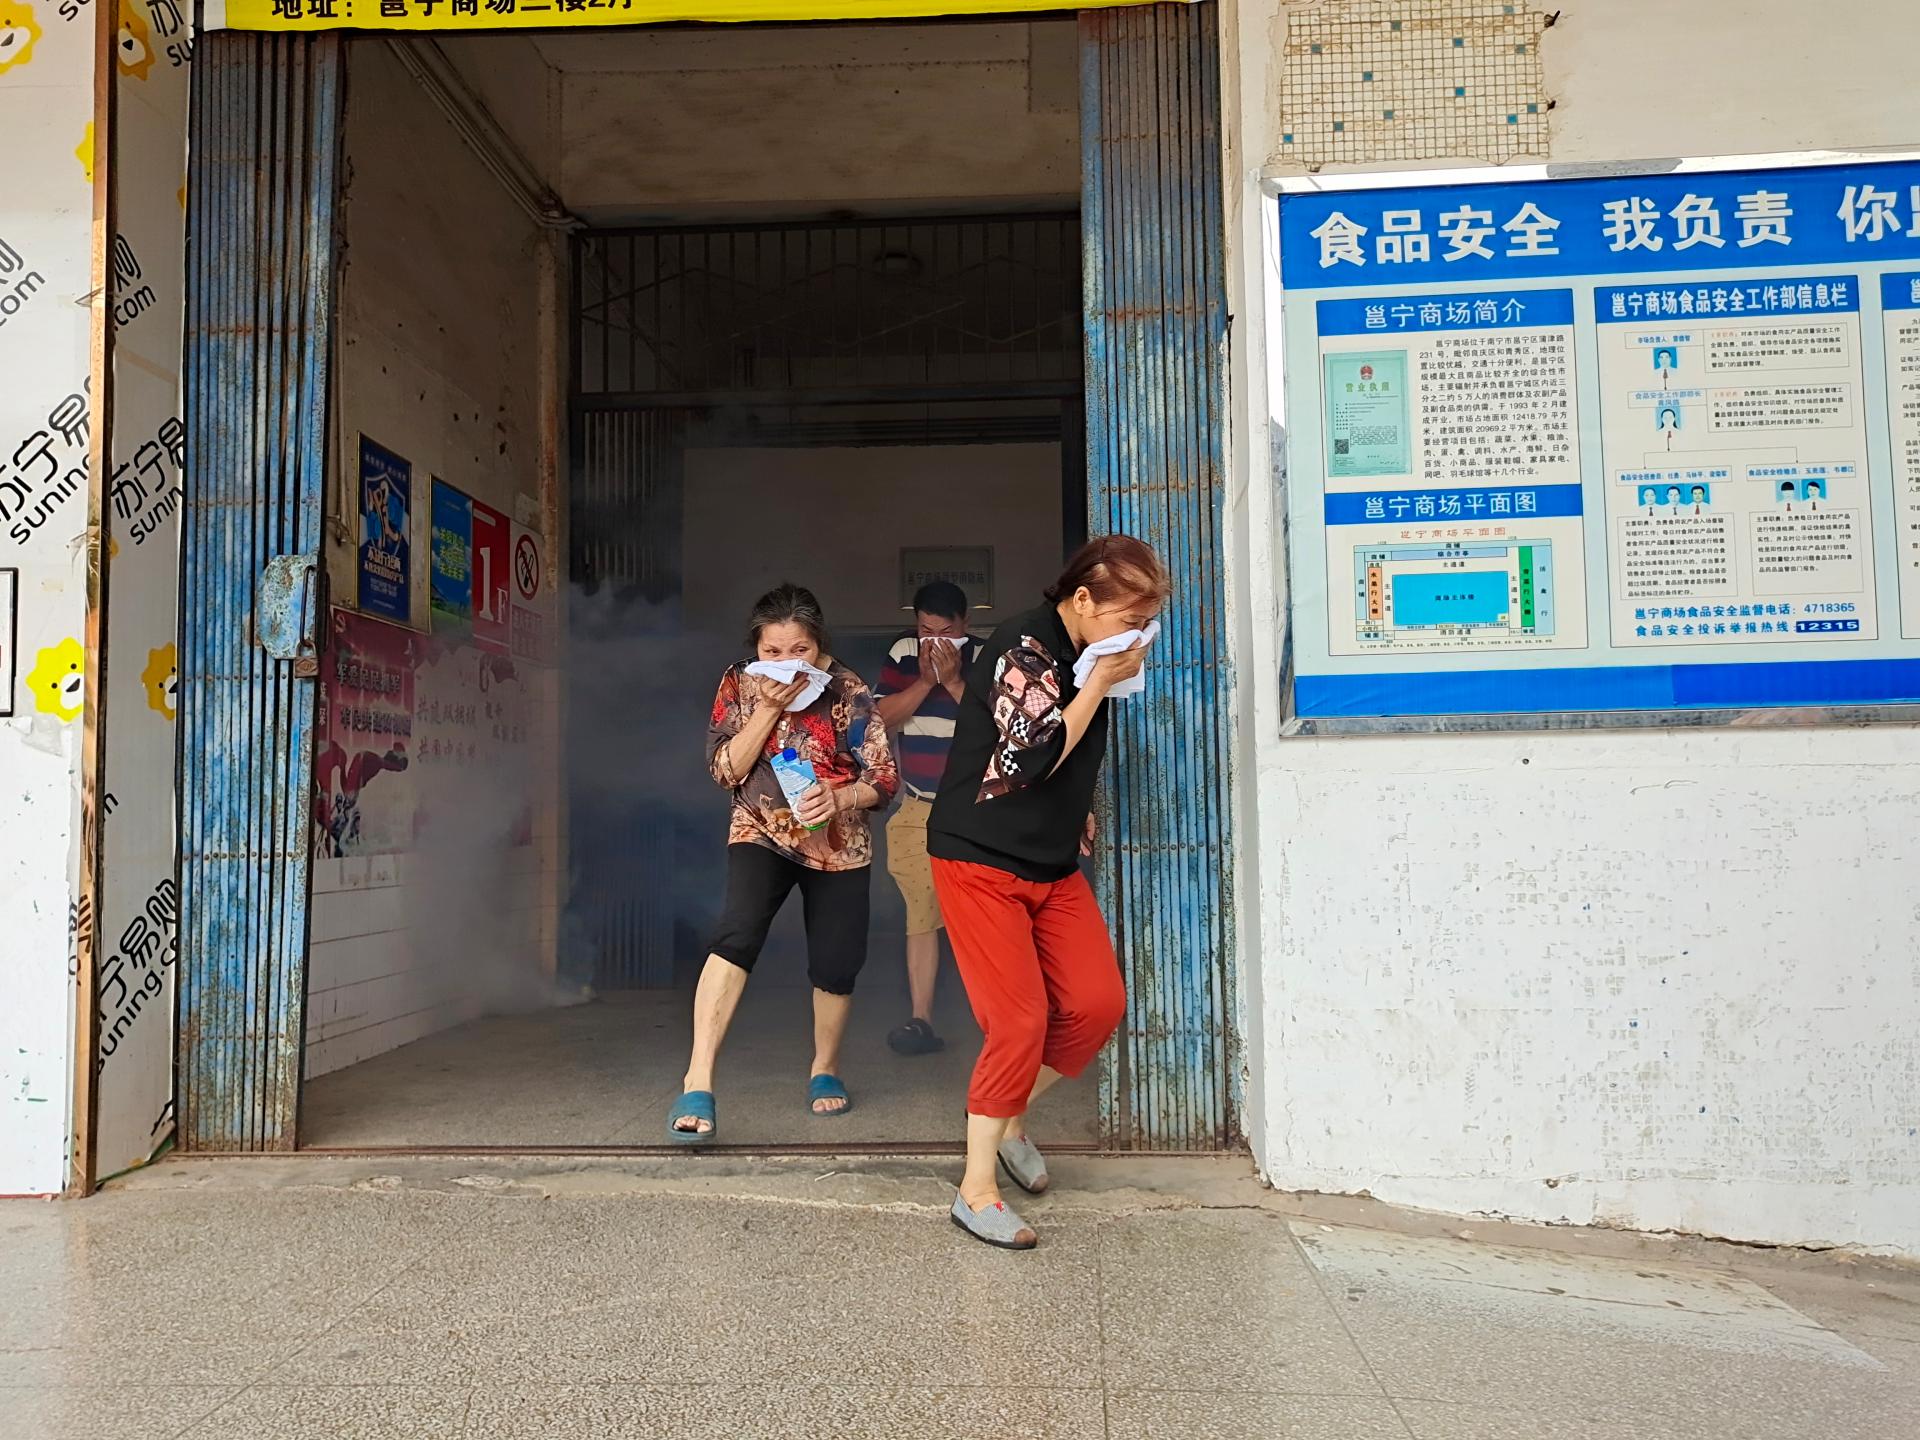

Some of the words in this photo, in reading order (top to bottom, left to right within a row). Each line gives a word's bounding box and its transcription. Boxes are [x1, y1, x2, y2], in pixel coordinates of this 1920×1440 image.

[1310, 201, 1561, 268] 食品安全
[1602, 190, 1793, 252] 我负责
[1837, 184, 1920, 242] 你
[1364, 297, 1526, 329] 邕宁商场简介
[1611, 283, 1848, 318] 邕宁商场食品安全工作部信息栏
[1365, 490, 1537, 520] 邕宁商场平面图
[1804, 602, 1856, 614] 4718365
[1798, 621, 1859, 632] 12315
